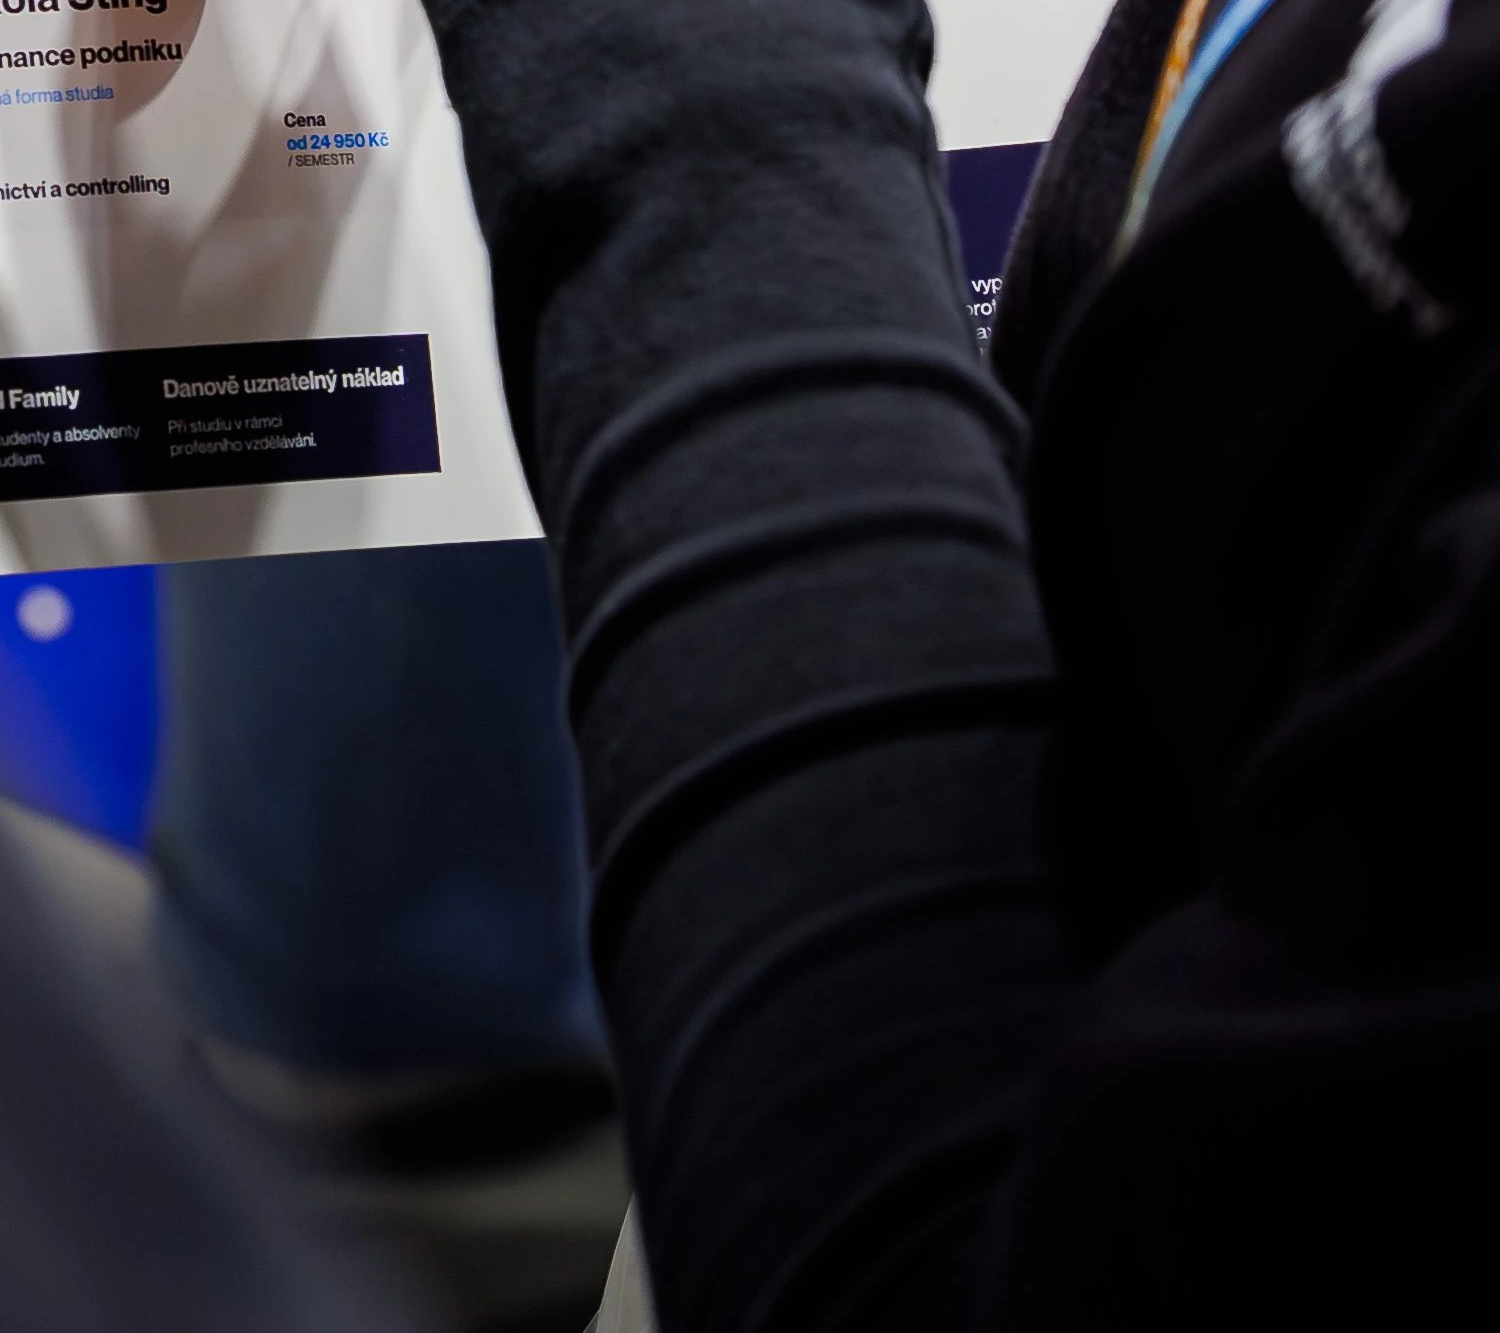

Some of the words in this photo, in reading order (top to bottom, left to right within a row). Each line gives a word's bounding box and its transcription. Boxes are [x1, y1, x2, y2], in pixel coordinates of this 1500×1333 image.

[80, 39, 183, 69] podniku
[284, 112, 326, 128] Cena
[51, 185, 62, 197] a
[66, 175, 169, 196] controlling
[9, 386, 79, 409] Family
